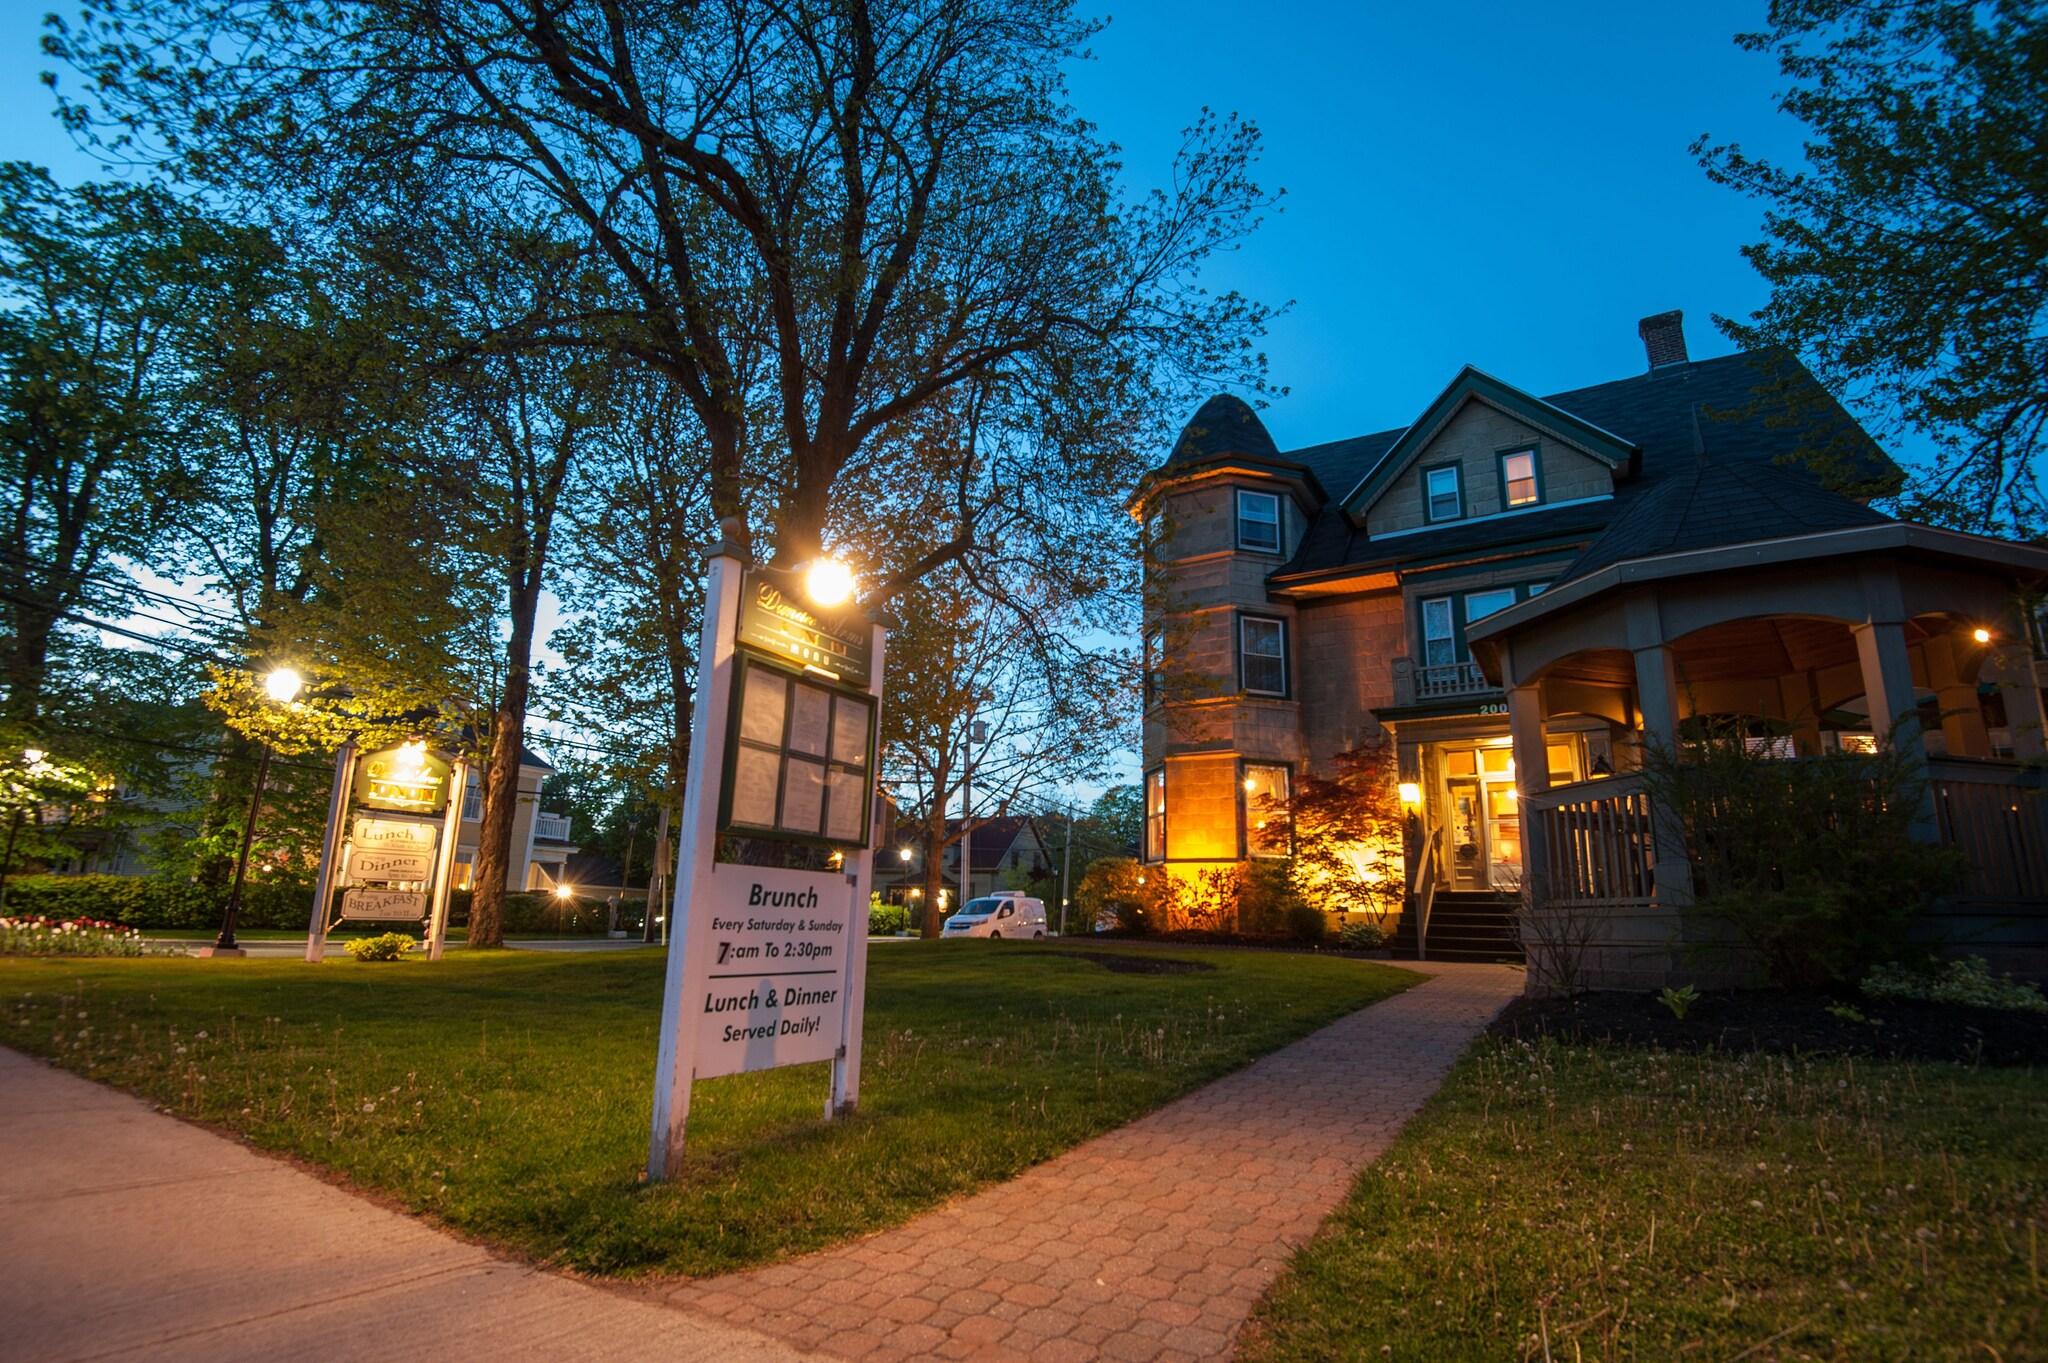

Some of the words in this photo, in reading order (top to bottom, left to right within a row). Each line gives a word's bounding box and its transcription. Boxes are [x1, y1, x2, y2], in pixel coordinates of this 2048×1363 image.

[1480, 703, 1509, 714] 200
[362, 827, 414, 841] Lunch
[360, 858, 419, 872] Dinner
[348, 894, 419, 911] BREAKFAST
[749, 883, 818, 908] Brunch
[712, 917, 744, 934] Every
[747, 918, 796, 933] Saturday
[798, 920, 806, 931] &
[808, 919, 843, 934] Sunday
[716, 942, 759, 965] 7:am
[765, 942, 780, 958] To
[784, 942, 833, 960] 2:30pm
[704, 989, 759, 1013] Lunch
[765, 991, 778, 1008] &
[784, 987, 838, 1007] Dinner
[722, 1020, 777, 1042] Served
[780, 1016, 821, 1036] Daily!
